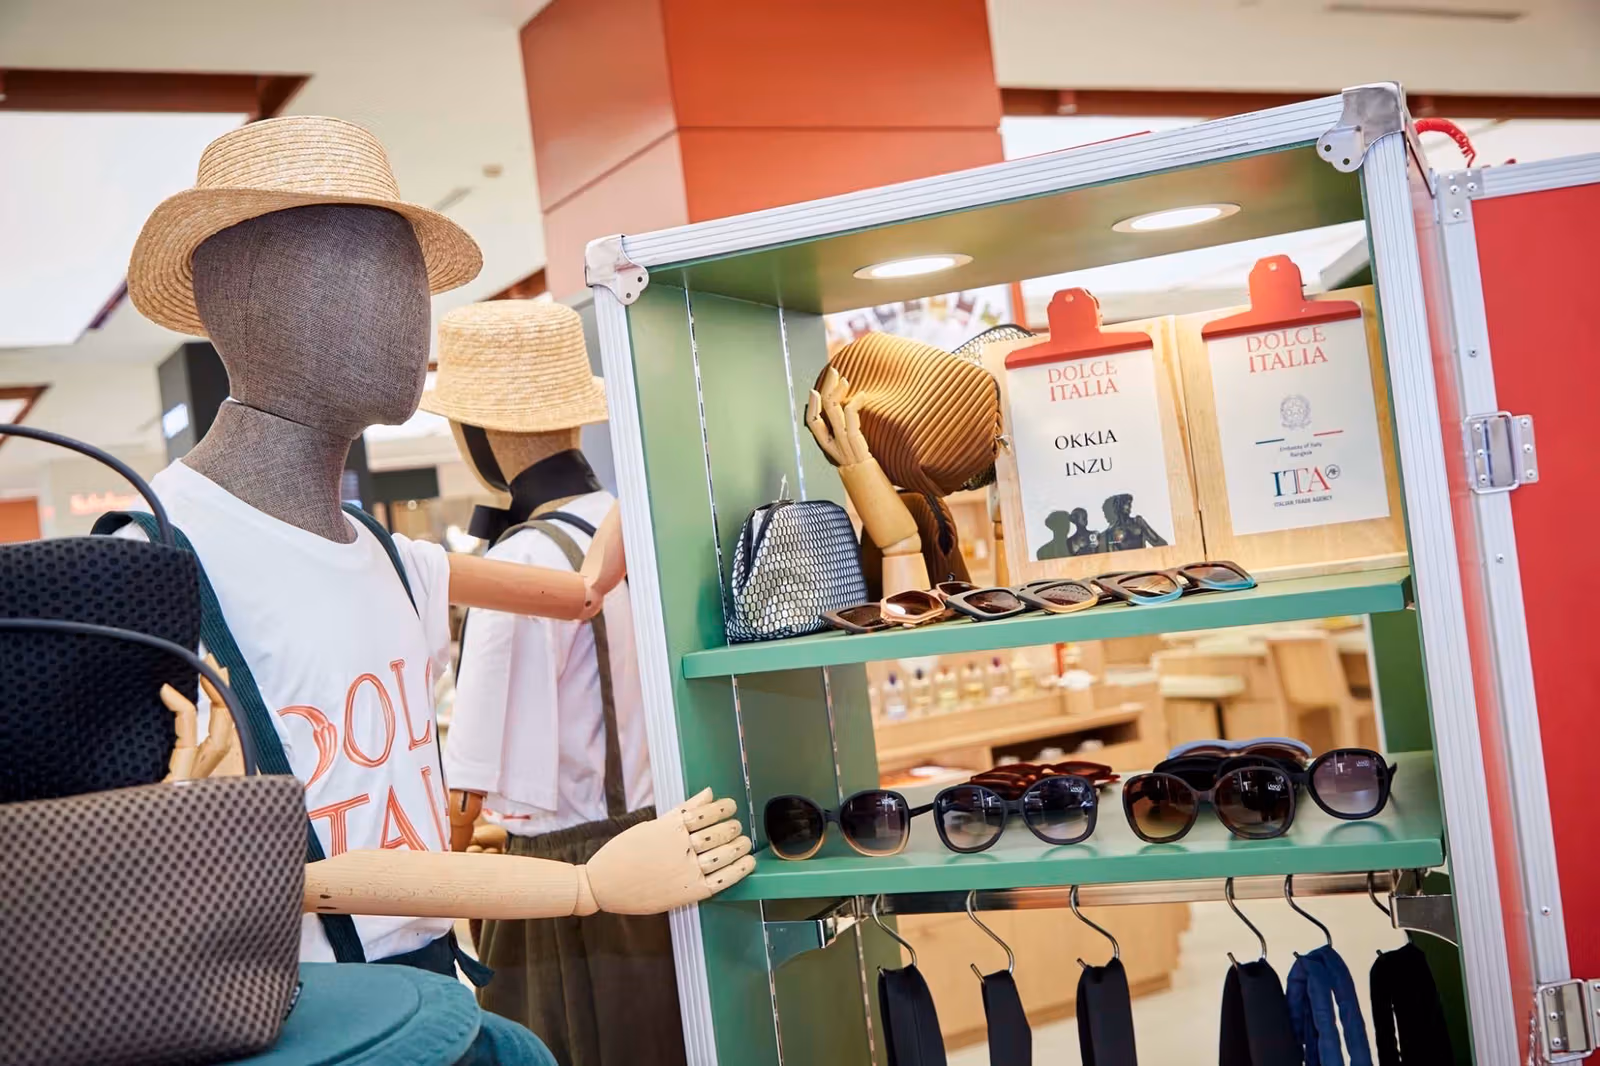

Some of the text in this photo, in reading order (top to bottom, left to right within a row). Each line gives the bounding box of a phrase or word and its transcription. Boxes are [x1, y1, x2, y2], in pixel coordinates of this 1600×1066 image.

[1246, 326, 1326, 353] DOLCE
[1047, 360, 1118, 384] DOLCE
[1249, 346, 1328, 373] ITALIA
[1049, 377, 1119, 402] ITALIA
[1054, 429, 1118, 450] OKKIA
[1066, 457, 1113, 476] INZU
[1270, 466, 1331, 497] ITA
[1274, 500, 1294, 508] ITALIAN
[276, 657, 433, 790] DOL
